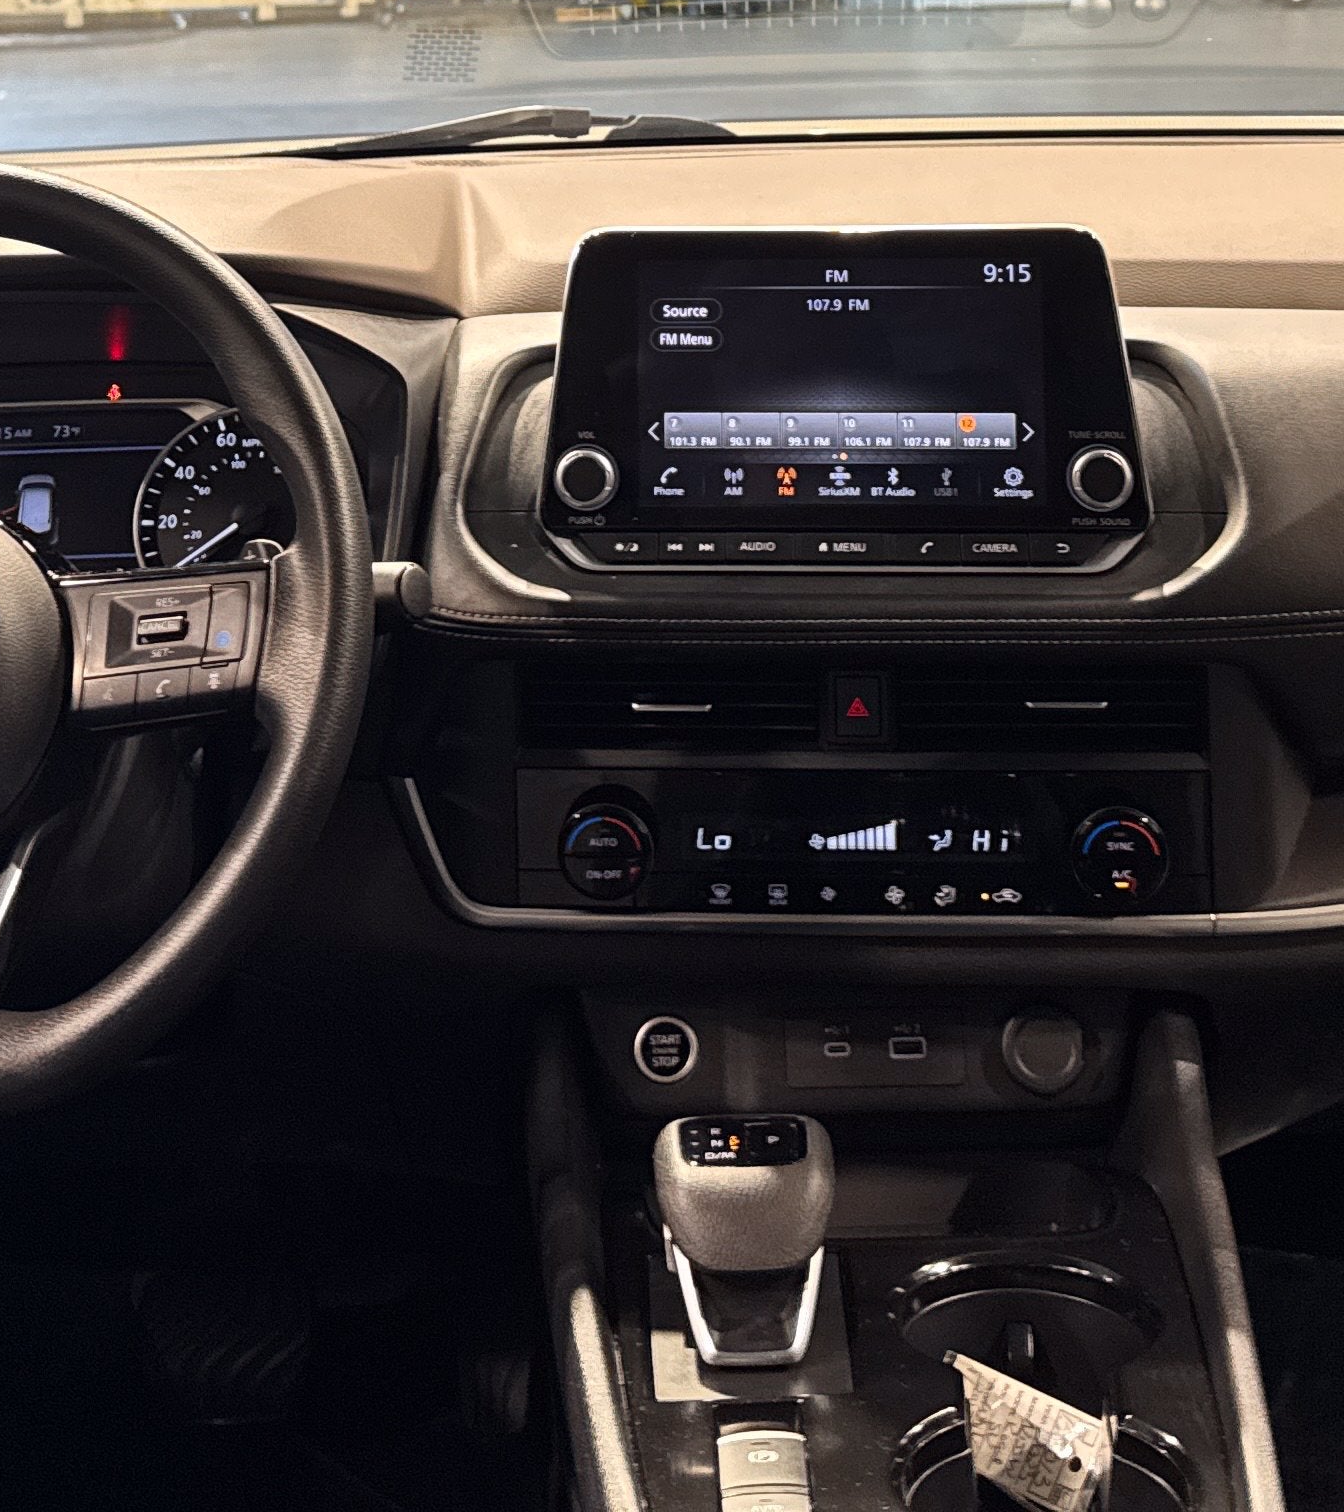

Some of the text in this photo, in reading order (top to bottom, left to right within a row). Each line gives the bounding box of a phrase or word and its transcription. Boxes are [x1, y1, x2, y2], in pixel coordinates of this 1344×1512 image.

[825, 269, 849, 283] FM
[983, 263, 1032, 283] 9:15
[806, 298, 870, 311] 107.9 FM
[662, 304, 709, 318] Source
[659, 333, 713, 346] FM Menu
[670, 418, 677, 428] 7
[728, 418, 736, 428] 8
[786, 418, 794, 428] 9
[843, 418, 856, 428] 10
[902, 418, 915, 428] 11
[961, 418, 973, 428] 12
[216, 432, 237, 447] 60
[669, 437, 717, 447] 101.3 FM
[729, 437, 772, 447] 90.1 FM
[788, 437, 830, 447] 99.1 FM
[844, 437, 892, 447] 106.1 FM
[903, 437, 951, 447] 107.9 FM
[962, 437, 1010, 447] 107.9 FM
[231, 460, 247, 469] 100
[175, 465, 195, 480] 40
[653, 486, 685, 496] Phone
[723, 486, 743, 496] AM
[778, 486, 794, 496] FM
[818, 486, 860, 497] SiriusXM
[871, 487, 916, 497] BT Audio
[993, 487, 1034, 499] Settings
[158, 514, 177, 529] 20
[190, 530, 202, 539] 20
[740, 541, 776, 551] AUDIO
[833, 542, 867, 552] MENU
[972, 543, 1018, 553] CAMERA
[589, 838, 618, 847] AUTO
[696, 827, 732, 851] Lo
[972, 829, 1009, 852] Hi
[1106, 841, 1135, 851] SYNC
[1112, 870, 1133, 879] A/C
[649, 1034, 682, 1045] START
[652, 1056, 681, 1067] STOP
